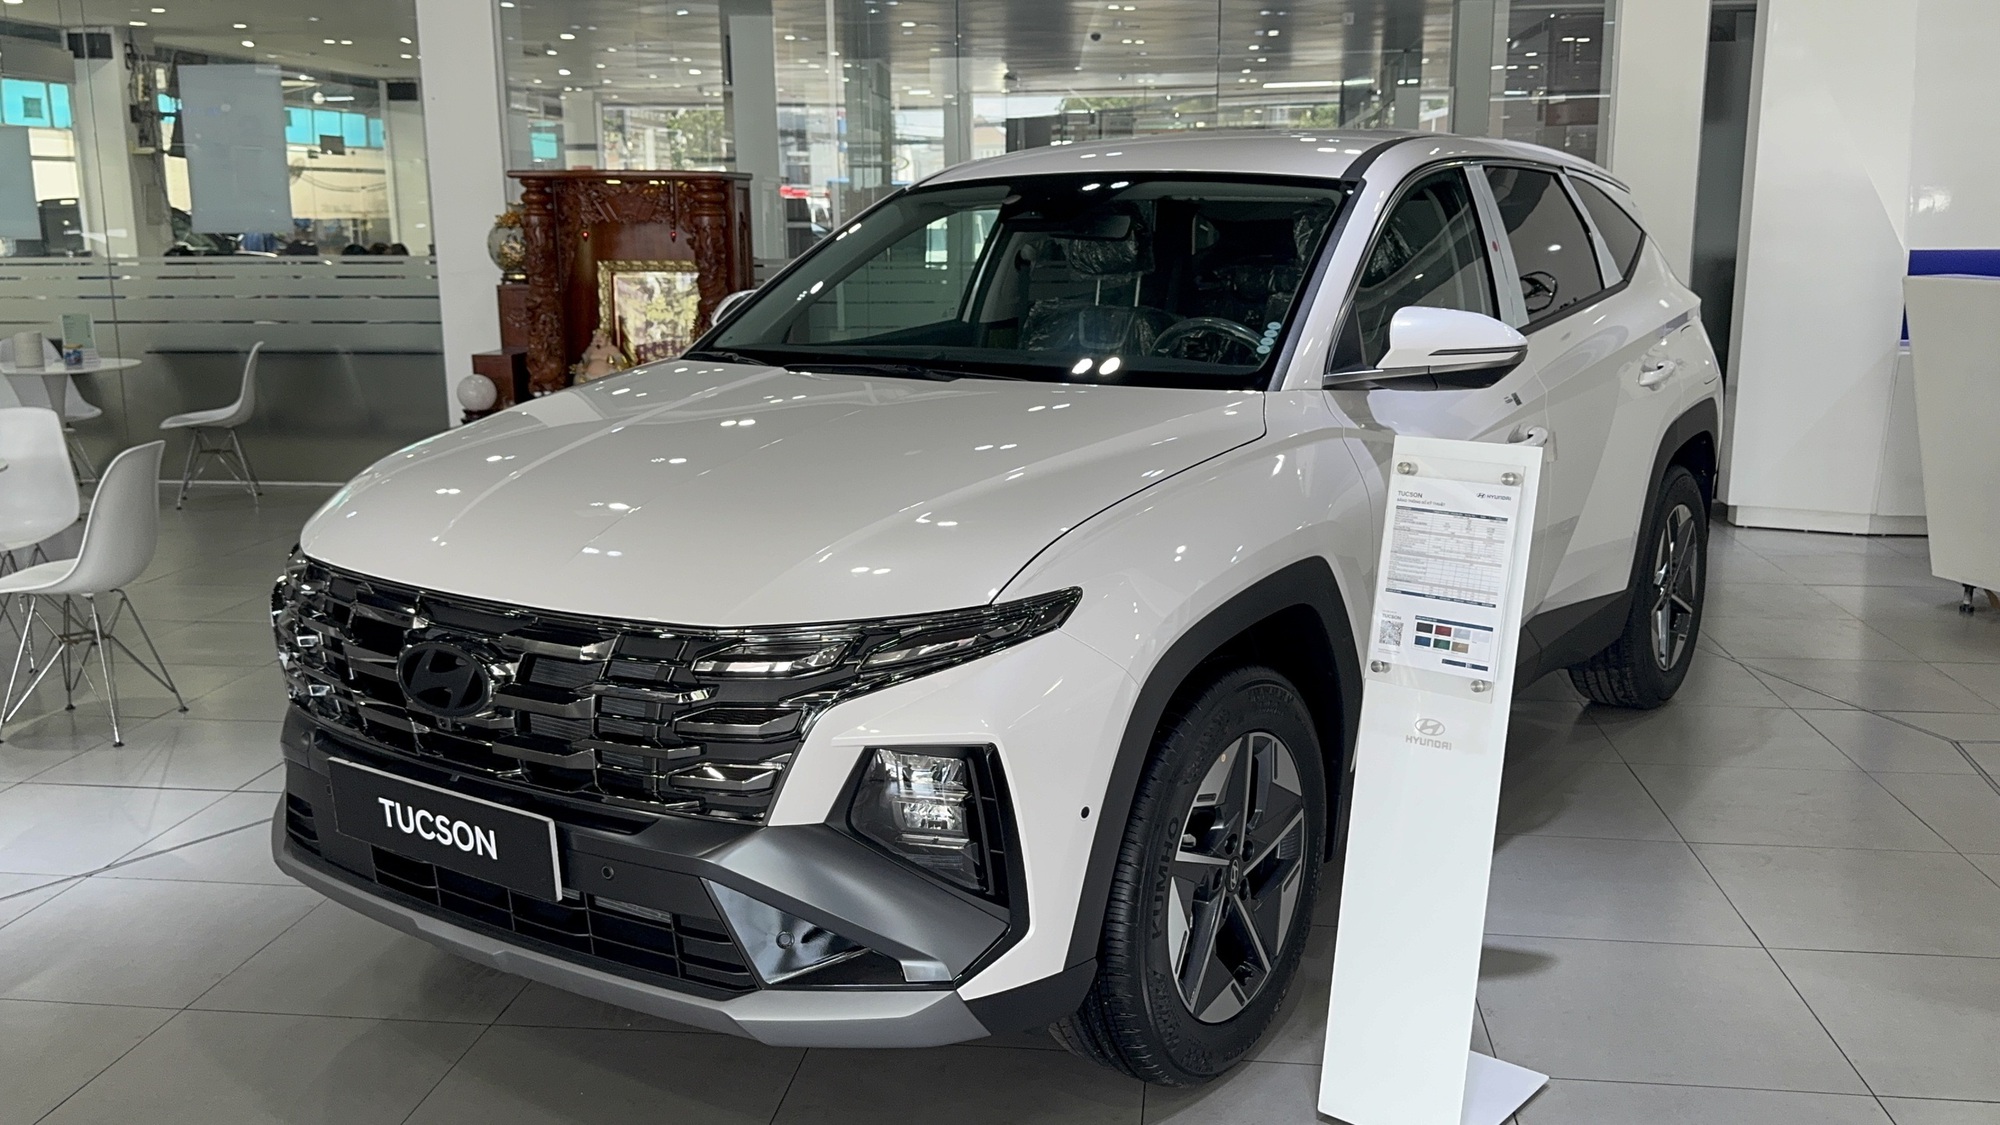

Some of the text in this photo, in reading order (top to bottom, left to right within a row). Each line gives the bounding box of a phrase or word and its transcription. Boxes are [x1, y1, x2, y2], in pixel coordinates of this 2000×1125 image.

[1398, 490, 1423, 498] TUCSON
[1486, 493, 1511, 501] HYUNDAI
[1405, 734, 1453, 751] HYUNDAI
[378, 797, 498, 860] TUCSON
[1151, 816, 1180, 940] KUMHO
